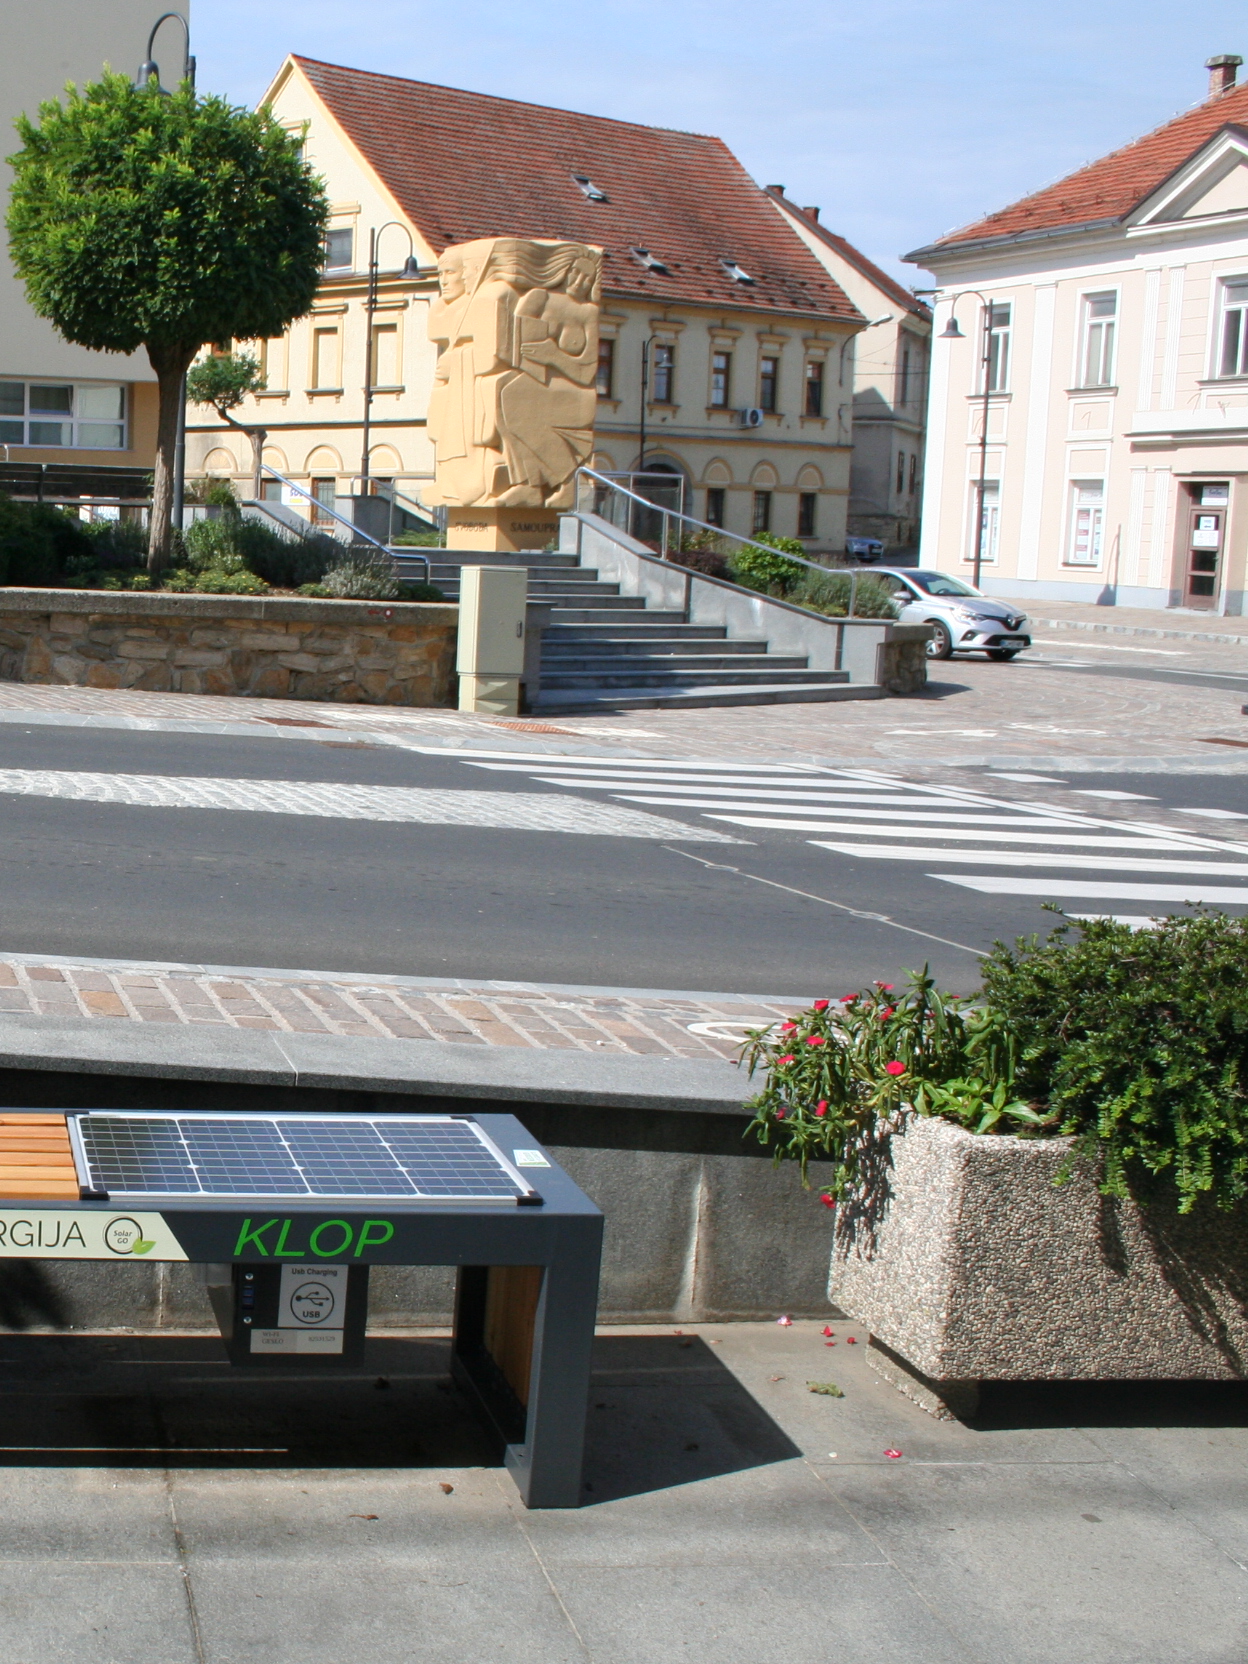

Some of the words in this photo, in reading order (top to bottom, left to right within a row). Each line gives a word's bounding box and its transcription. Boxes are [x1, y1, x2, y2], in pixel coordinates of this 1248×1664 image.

[233, 1218, 395, 1258] KLOP
[306, 1268, 338, 1277] Charging
[302, 1310, 321, 1318] USB
